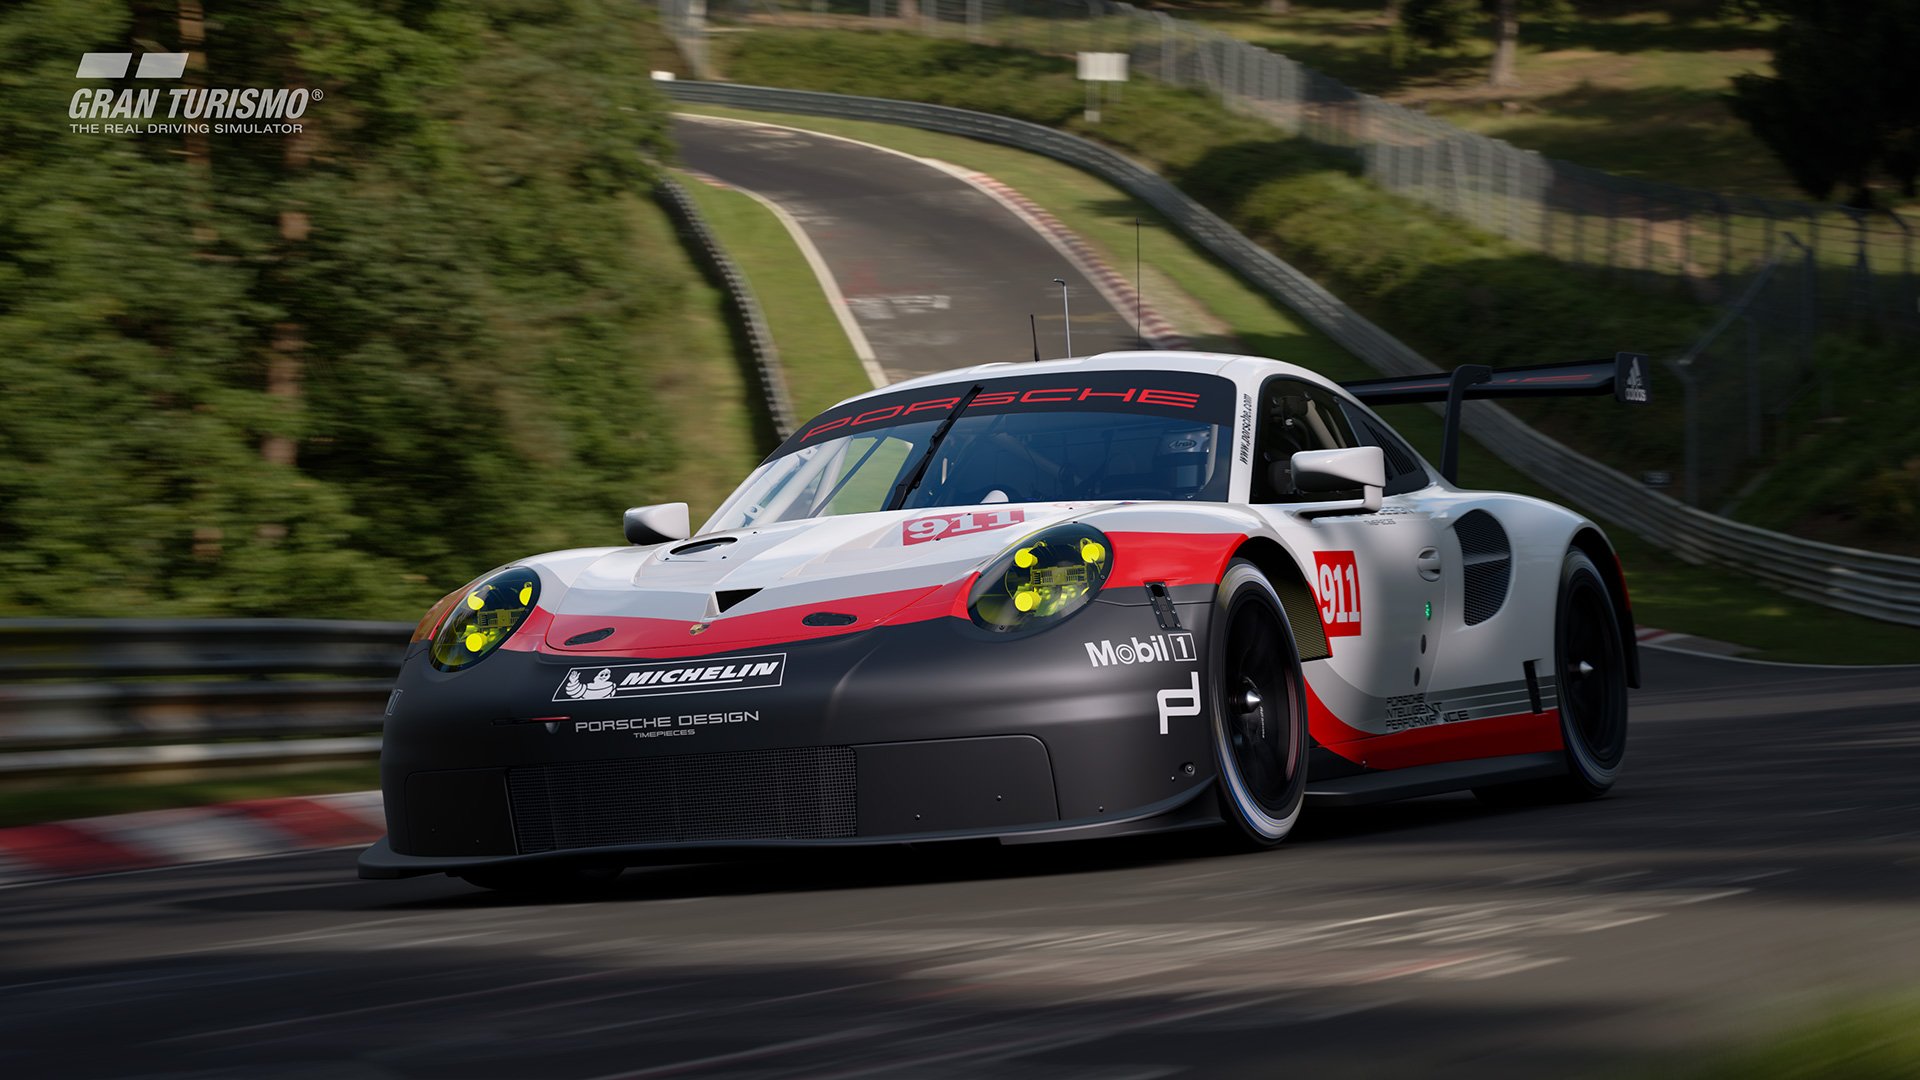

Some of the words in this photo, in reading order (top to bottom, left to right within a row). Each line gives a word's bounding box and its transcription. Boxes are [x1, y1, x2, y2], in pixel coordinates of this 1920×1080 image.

[800, 387, 1200, 443] PORSCHE
[907, 511, 1020, 539] 911
[1320, 563, 1360, 624] 911
[1084, 635, 1170, 668] Mobil
[619, 661, 780, 687] MICHELIN
[575, 716, 672, 733] PORSCHE
[678, 710, 760, 727] DESIGN
[633, 728, 696, 739] TIMEPIECES
